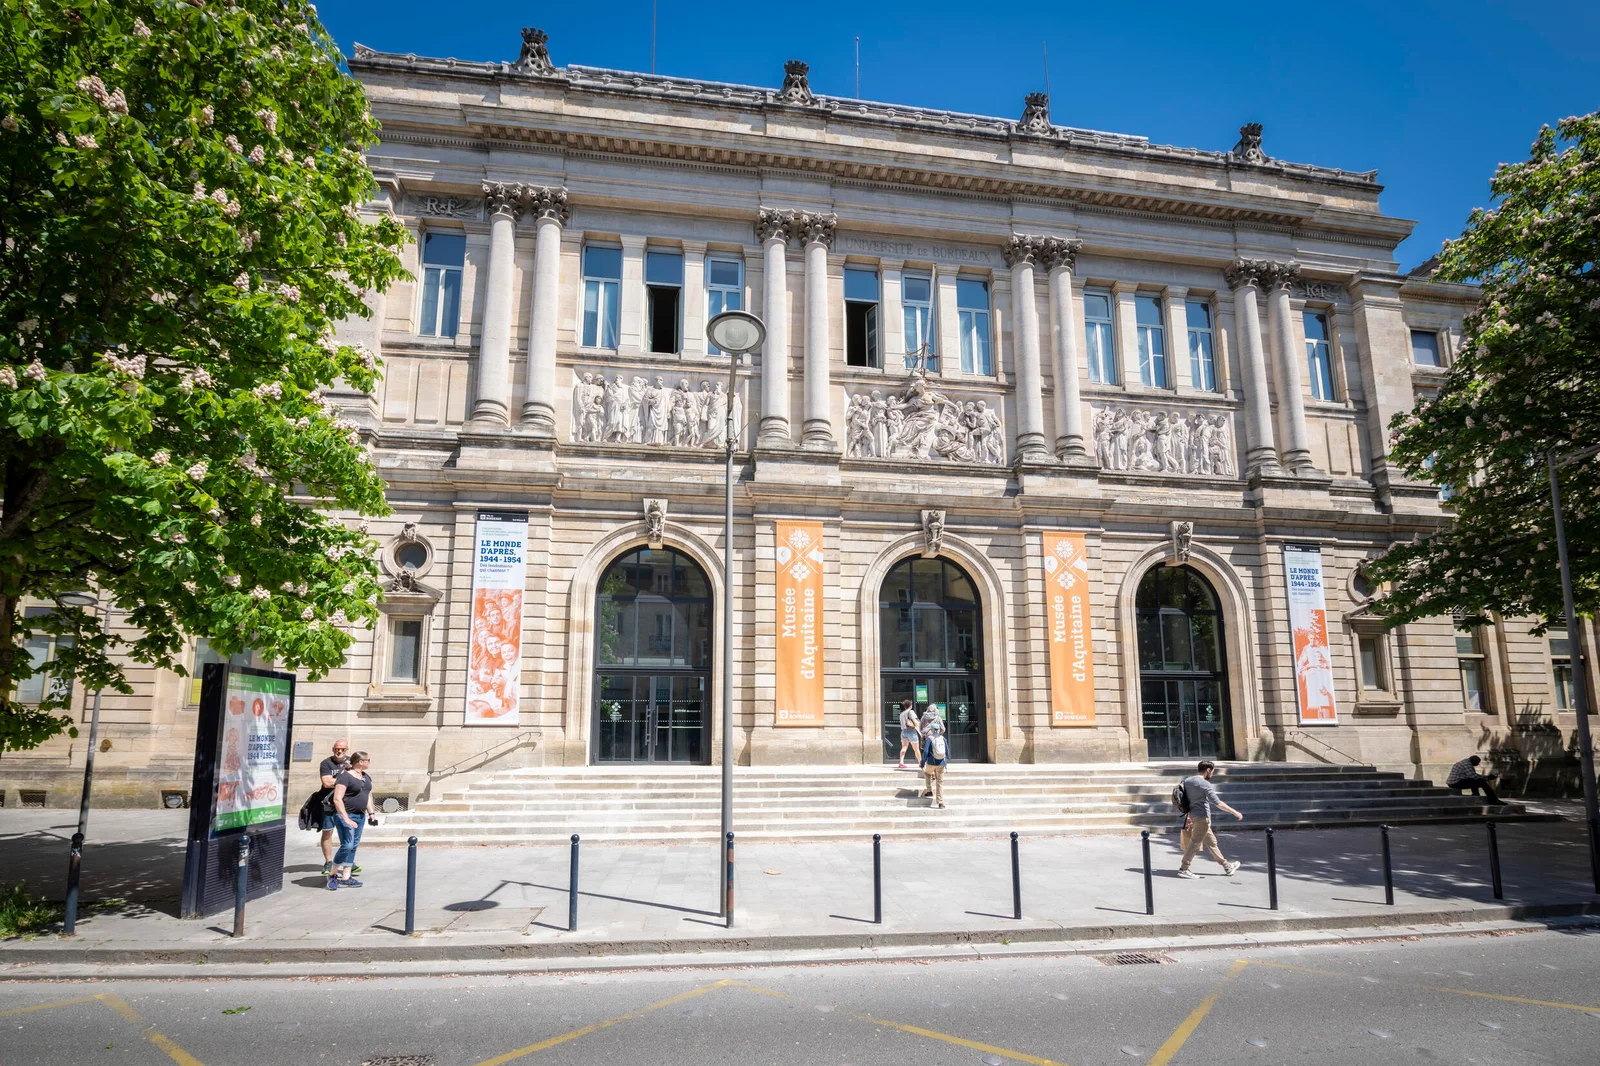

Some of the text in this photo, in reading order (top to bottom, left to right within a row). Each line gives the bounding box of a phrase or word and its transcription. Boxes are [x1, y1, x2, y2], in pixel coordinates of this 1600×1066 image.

[933, 246, 991, 263] BORDEAUX
[493, 540, 522, 548] MONDE
[781, 587, 796, 638] Musée
[1051, 595, 1066, 643] Musée
[800, 588, 818, 680] d'Aquitaine
[1069, 595, 1087, 682] d'Aquitaine
[249, 734, 275, 742] LE MONDE
[247, 752, 260, 760] 1944
[263, 752, 276, 760] 1954
